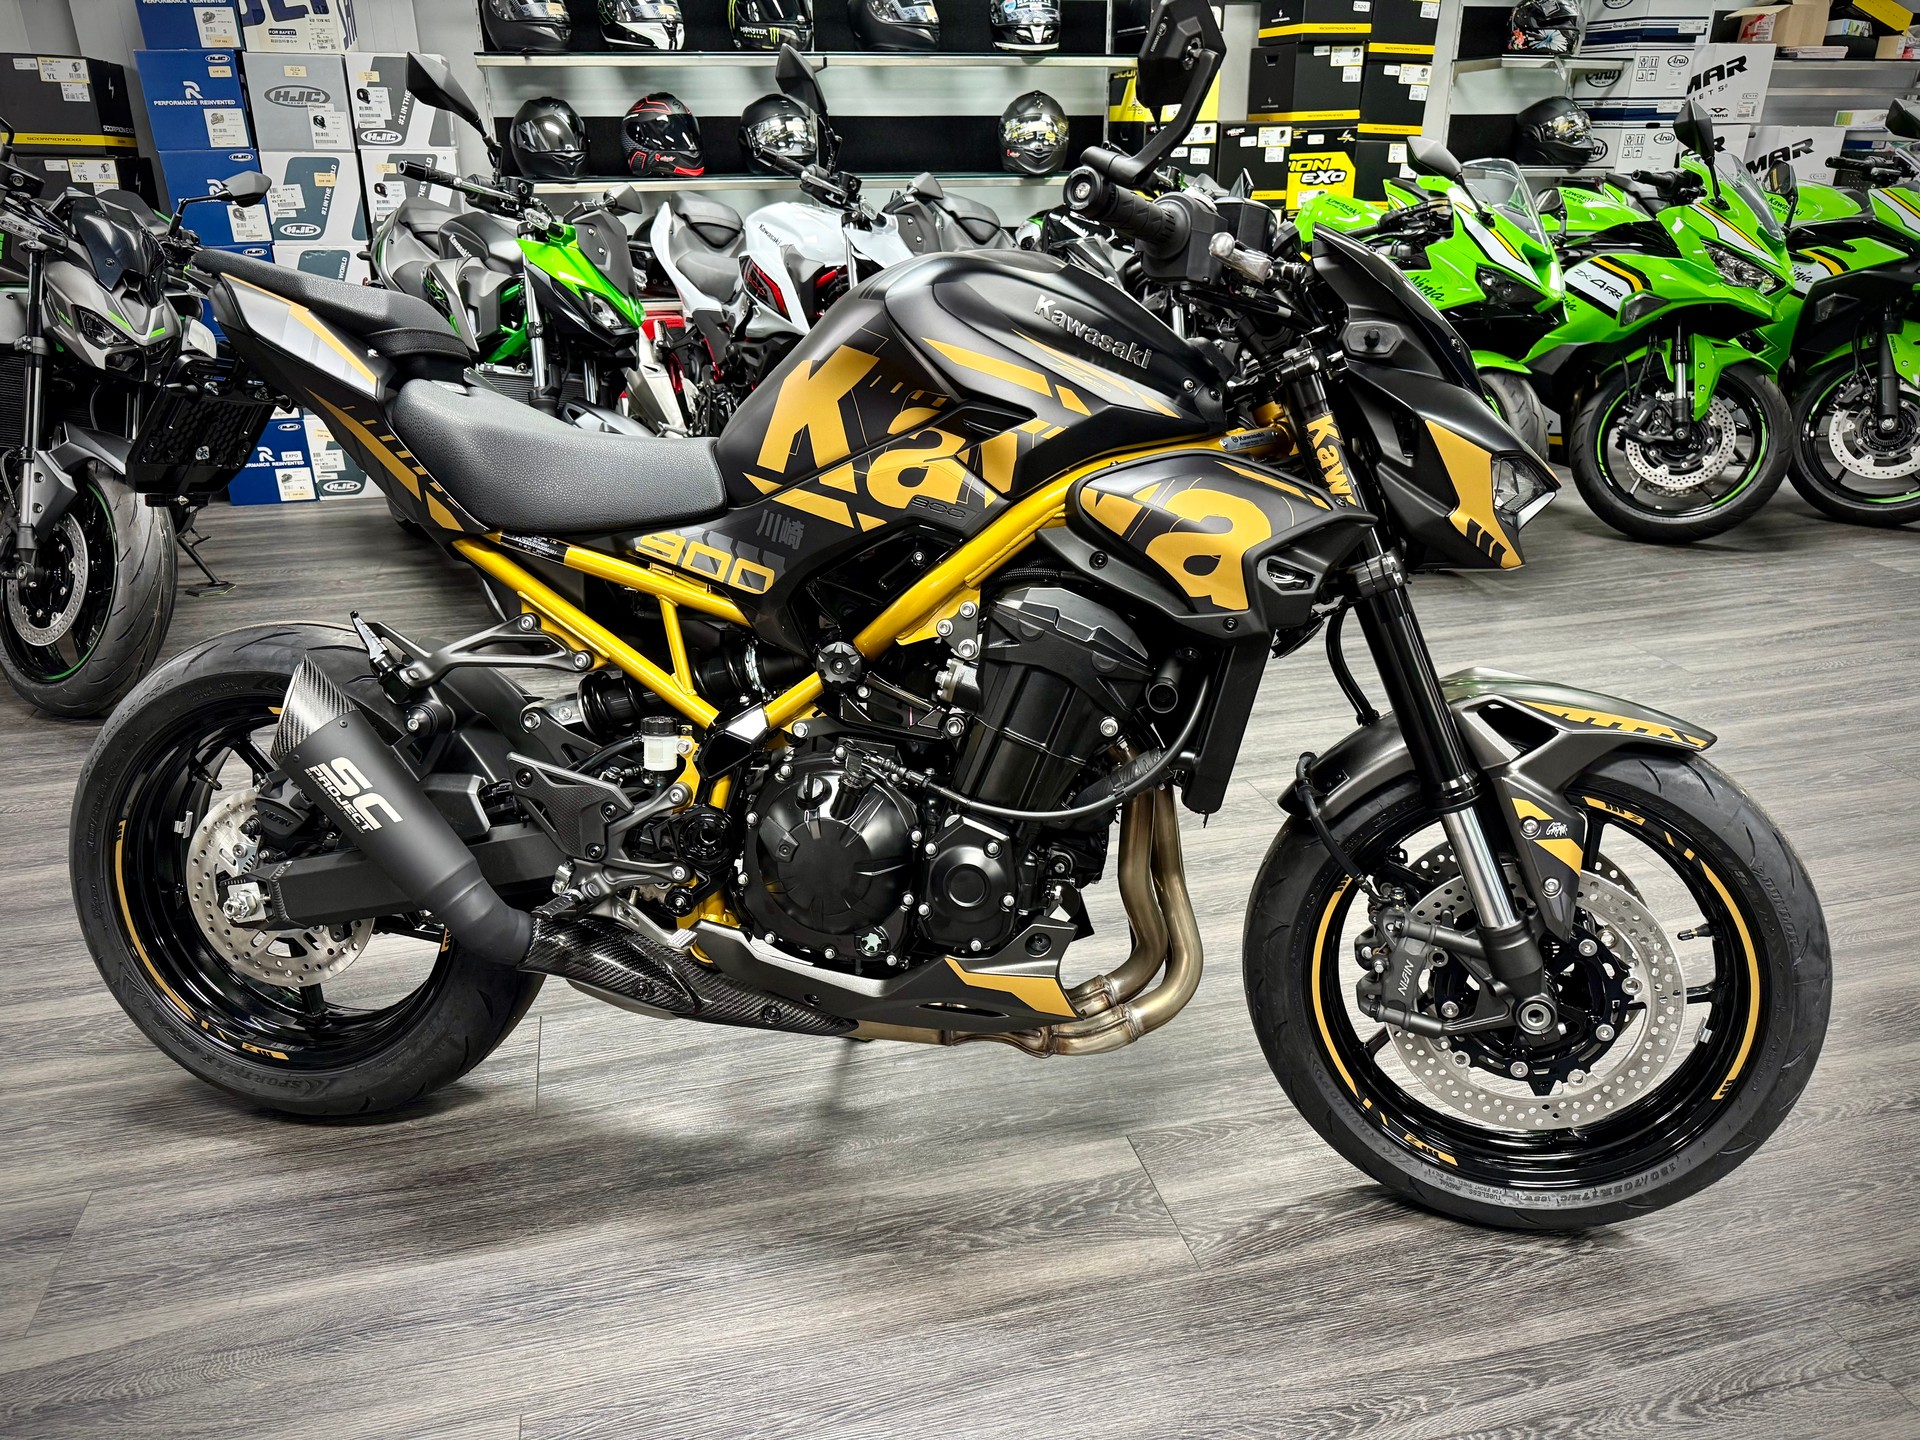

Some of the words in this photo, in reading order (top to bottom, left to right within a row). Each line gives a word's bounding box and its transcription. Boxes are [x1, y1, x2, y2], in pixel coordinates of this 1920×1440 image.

[1670, 55, 1686, 64] Arai
[1687, 55, 1748, 95] MAR
[273, 91, 321, 102] HJC
[366, 133, 397, 142] HJC
[1659, 132, 1673, 141] Arai
[1288, 159, 1331, 171] ION
[1746, 138, 1814, 175] MAR
[1301, 171, 1347, 184] EXO
[1768, 197, 1804, 217] Kawaski
[759, 224, 782, 246] Kawasaki
[338, 257, 348, 279] WORLD
[1408, 275, 1445, 302] Ninja
[1034, 294, 1153, 370] Kawasaki
[329, 482, 355, 490] HJC
[911, 497, 967, 519] 900
[756, 509, 806, 550] 川崎
[635, 531, 776, 595] 900
[307, 763, 374, 834] PROJECT
[318, 757, 403, 830] SC
[341, 809, 365, 834] TECHNOLOGY
[1759, 872, 1800, 948] DUNLOP
[1396, 958, 1415, 997] NISSIN
[198, 1051, 301, 1089] SPORTMAX
[1318, 1077, 1370, 1137] DUNLOP
[1438, 1179, 1462, 1191] RADIAL
[1456, 1179, 1473, 1188] WHEEL
[1468, 1187, 1501, 1202] TUBELESS
[1474, 1184, 1491, 1192] FRONT
